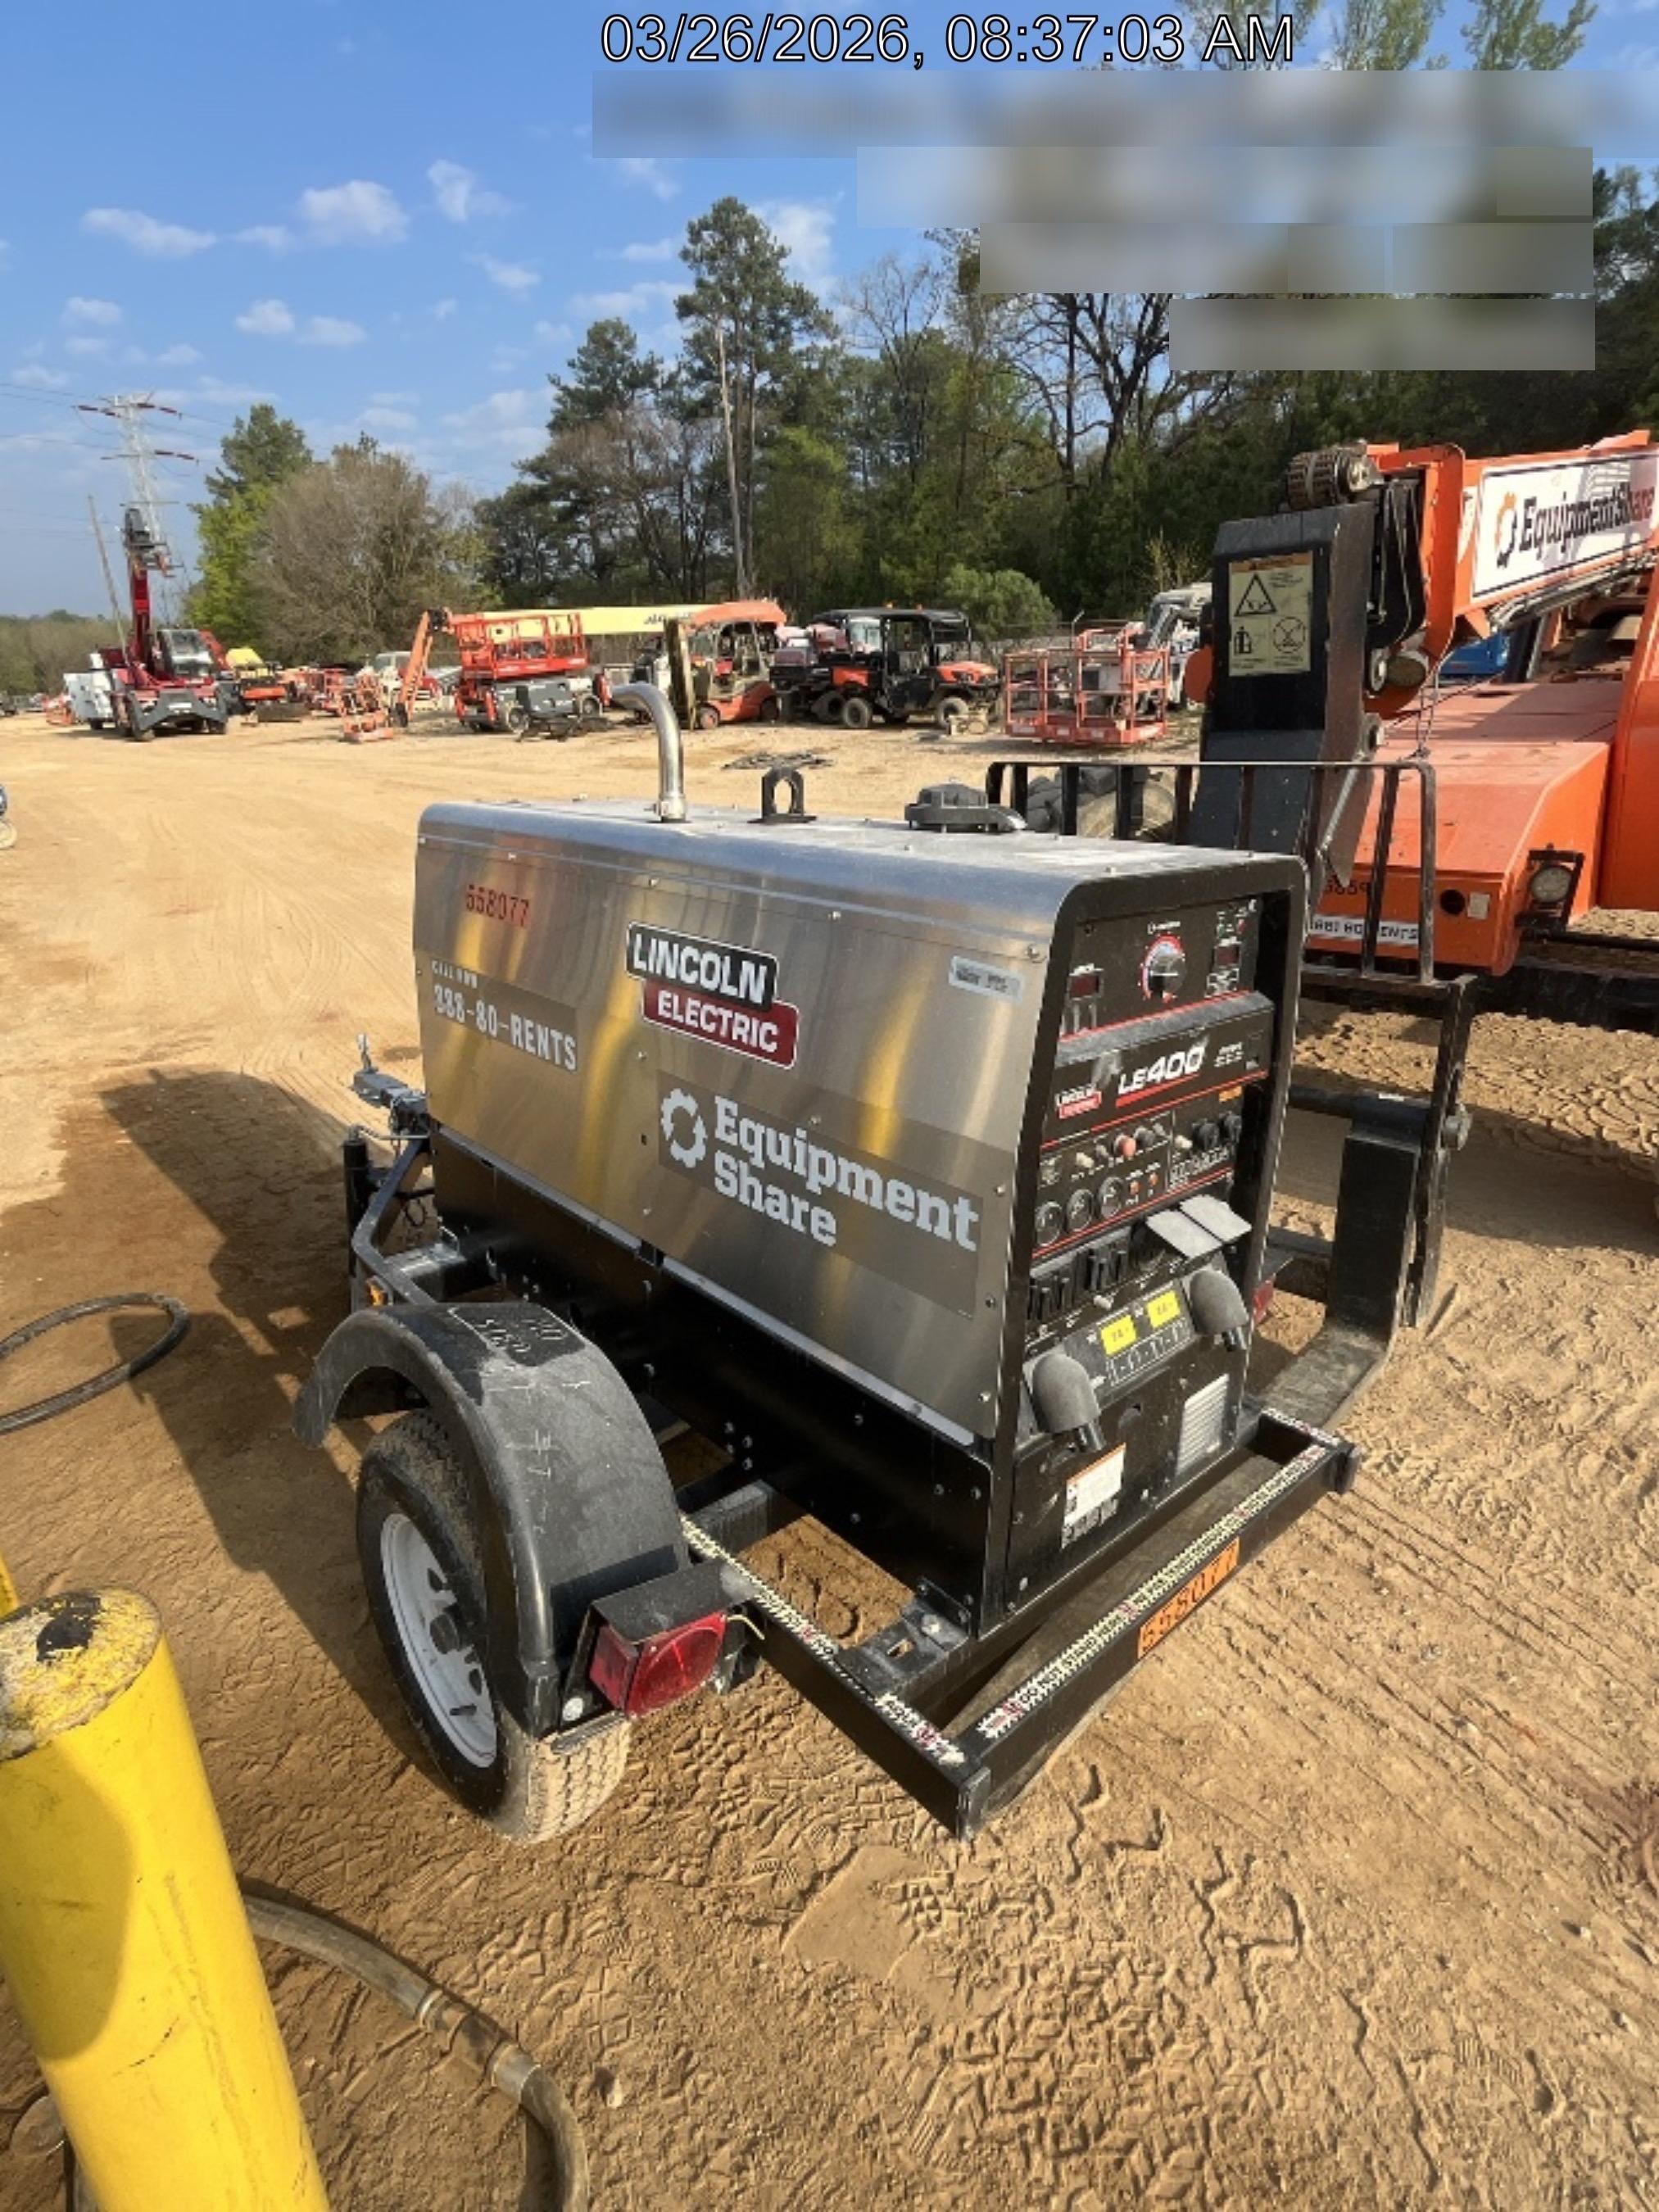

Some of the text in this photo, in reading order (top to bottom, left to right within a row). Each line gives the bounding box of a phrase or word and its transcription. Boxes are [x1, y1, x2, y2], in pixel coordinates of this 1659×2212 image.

[465, 884, 529, 927] 558077
[633, 932, 768, 1004] LINCOLN
[658, 990, 778, 1054] ELECTRIC
[1117, 1046, 1205, 1095] LE400
[714, 1095, 980, 1252] Equipment
[714, 1152, 837, 1248] Share
